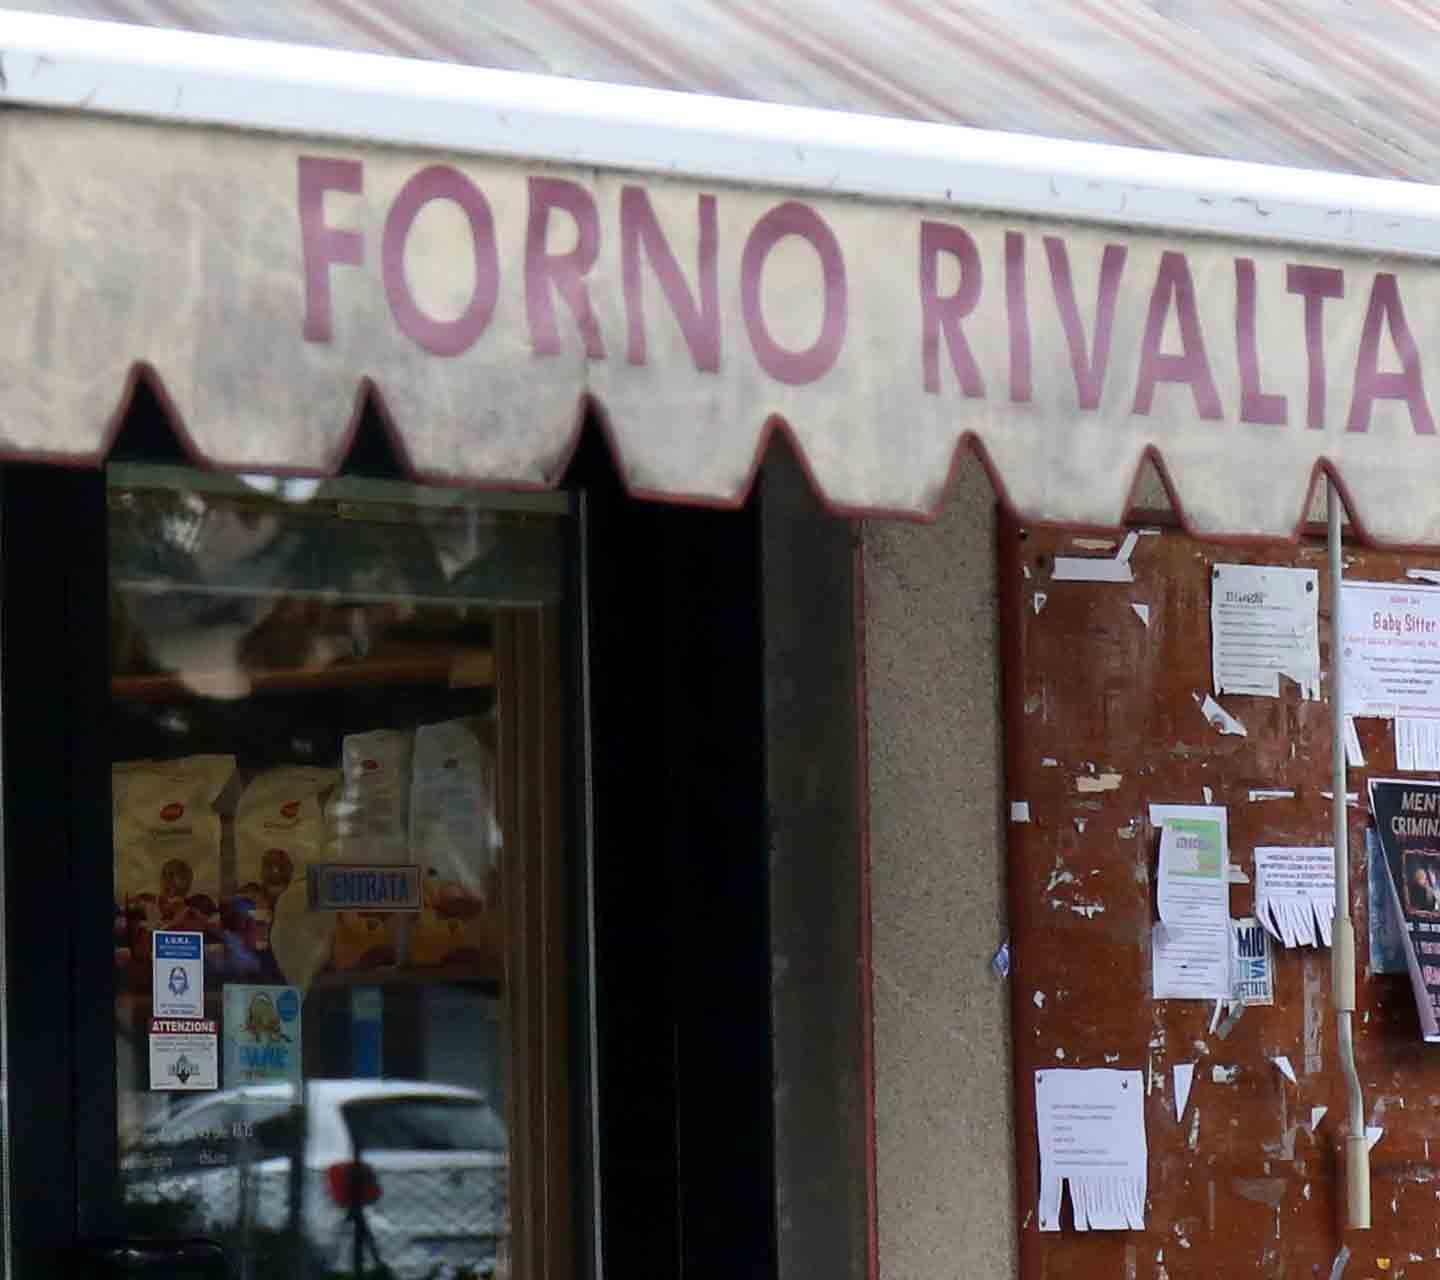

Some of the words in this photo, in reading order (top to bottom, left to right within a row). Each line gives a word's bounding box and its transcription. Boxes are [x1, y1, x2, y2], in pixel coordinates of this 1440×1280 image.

[298, 156, 847, 387] FORNO
[919, 220, 1437, 435] RIVALTA
[1373, 612, 1401, 636] Baby
[1405, 614, 1436, 632] Sitter
[1238, 928, 1264, 957] MIO
[152, 1021, 215, 1032] ATTENZIONE
